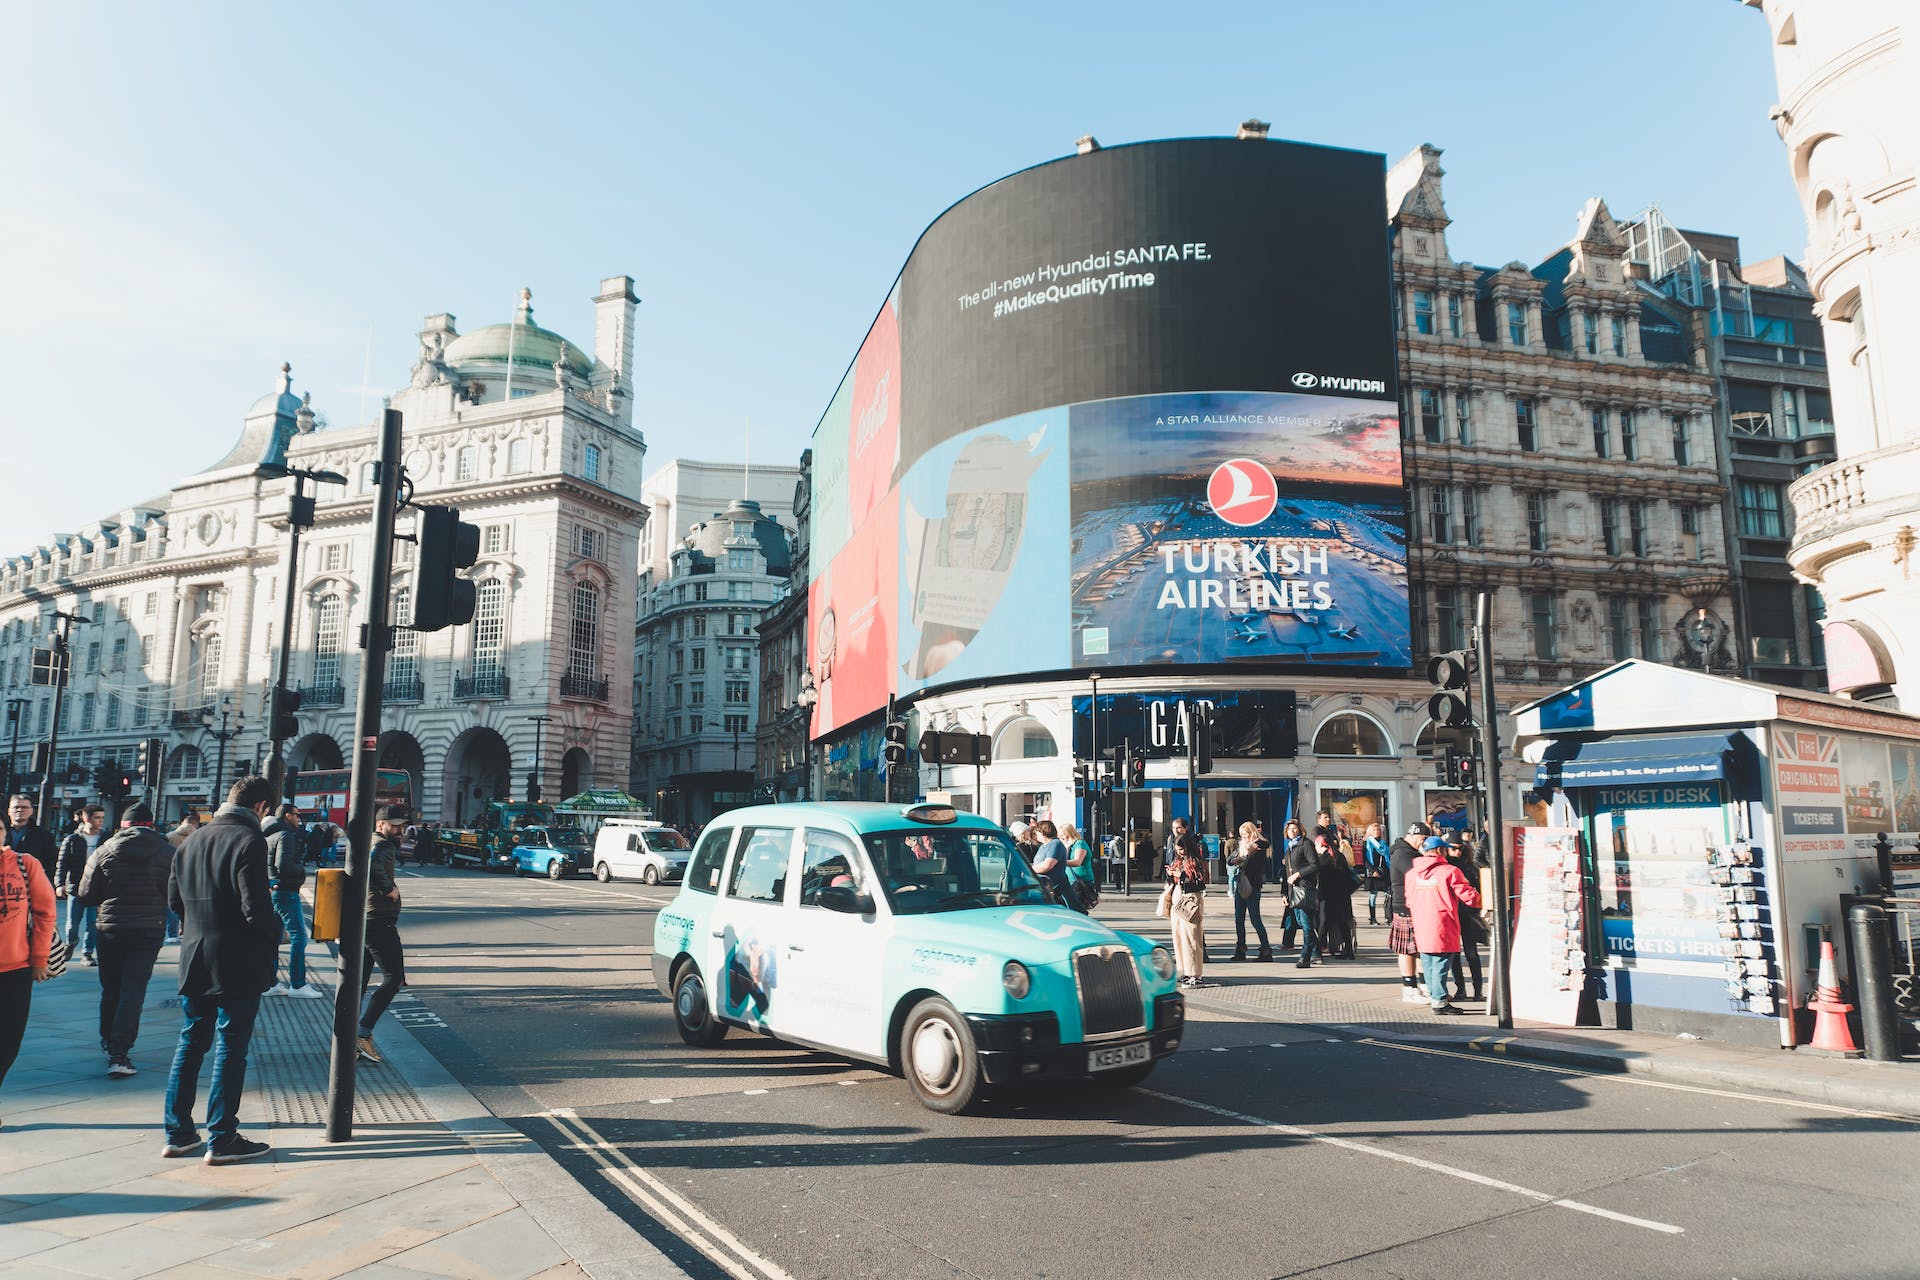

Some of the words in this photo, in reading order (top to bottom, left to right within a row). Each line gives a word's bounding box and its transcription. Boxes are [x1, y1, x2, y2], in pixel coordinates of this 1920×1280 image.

[958, 292, 980, 311] The
[981, 271, 1036, 301] all-new
[1038, 251, 1111, 282] Hyundai
[1114, 244, 1180, 267] SANTA
[1183, 242, 1212, 260] FE.
[993, 271, 1156, 318] #MakeQualityTime
[1321, 375, 1386, 394] HYUNDAI
[1155, 417, 1164, 426] A
[1167, 415, 1200, 425] STAR
[1203, 414, 1264, 424] ALLIANCE
[1267, 415, 1321, 426] MEMBER
[1157, 543, 1329, 575] TURKISH
[1156, 579, 1333, 611] AIRLINES
[1800, 740, 1816, 754] THE
[1587, 769, 1611, 777] London
[1643, 767, 1657, 775] Buy
[1676, 765, 1700, 773] tickets
[1780, 771, 1818, 786] ORIGINAL
[1818, 773, 1839, 787] TOUR
[1600, 788, 1659, 805] TICKET
[1663, 787, 1712, 803] DESK
[1792, 813, 1818, 825] TICKETS
[1818, 813, 1835, 825] HERE
[661, 912, 695, 931] rightmove
[1608, 936, 1676, 954] TICKETS
[914, 945, 977, 966] rightmove
